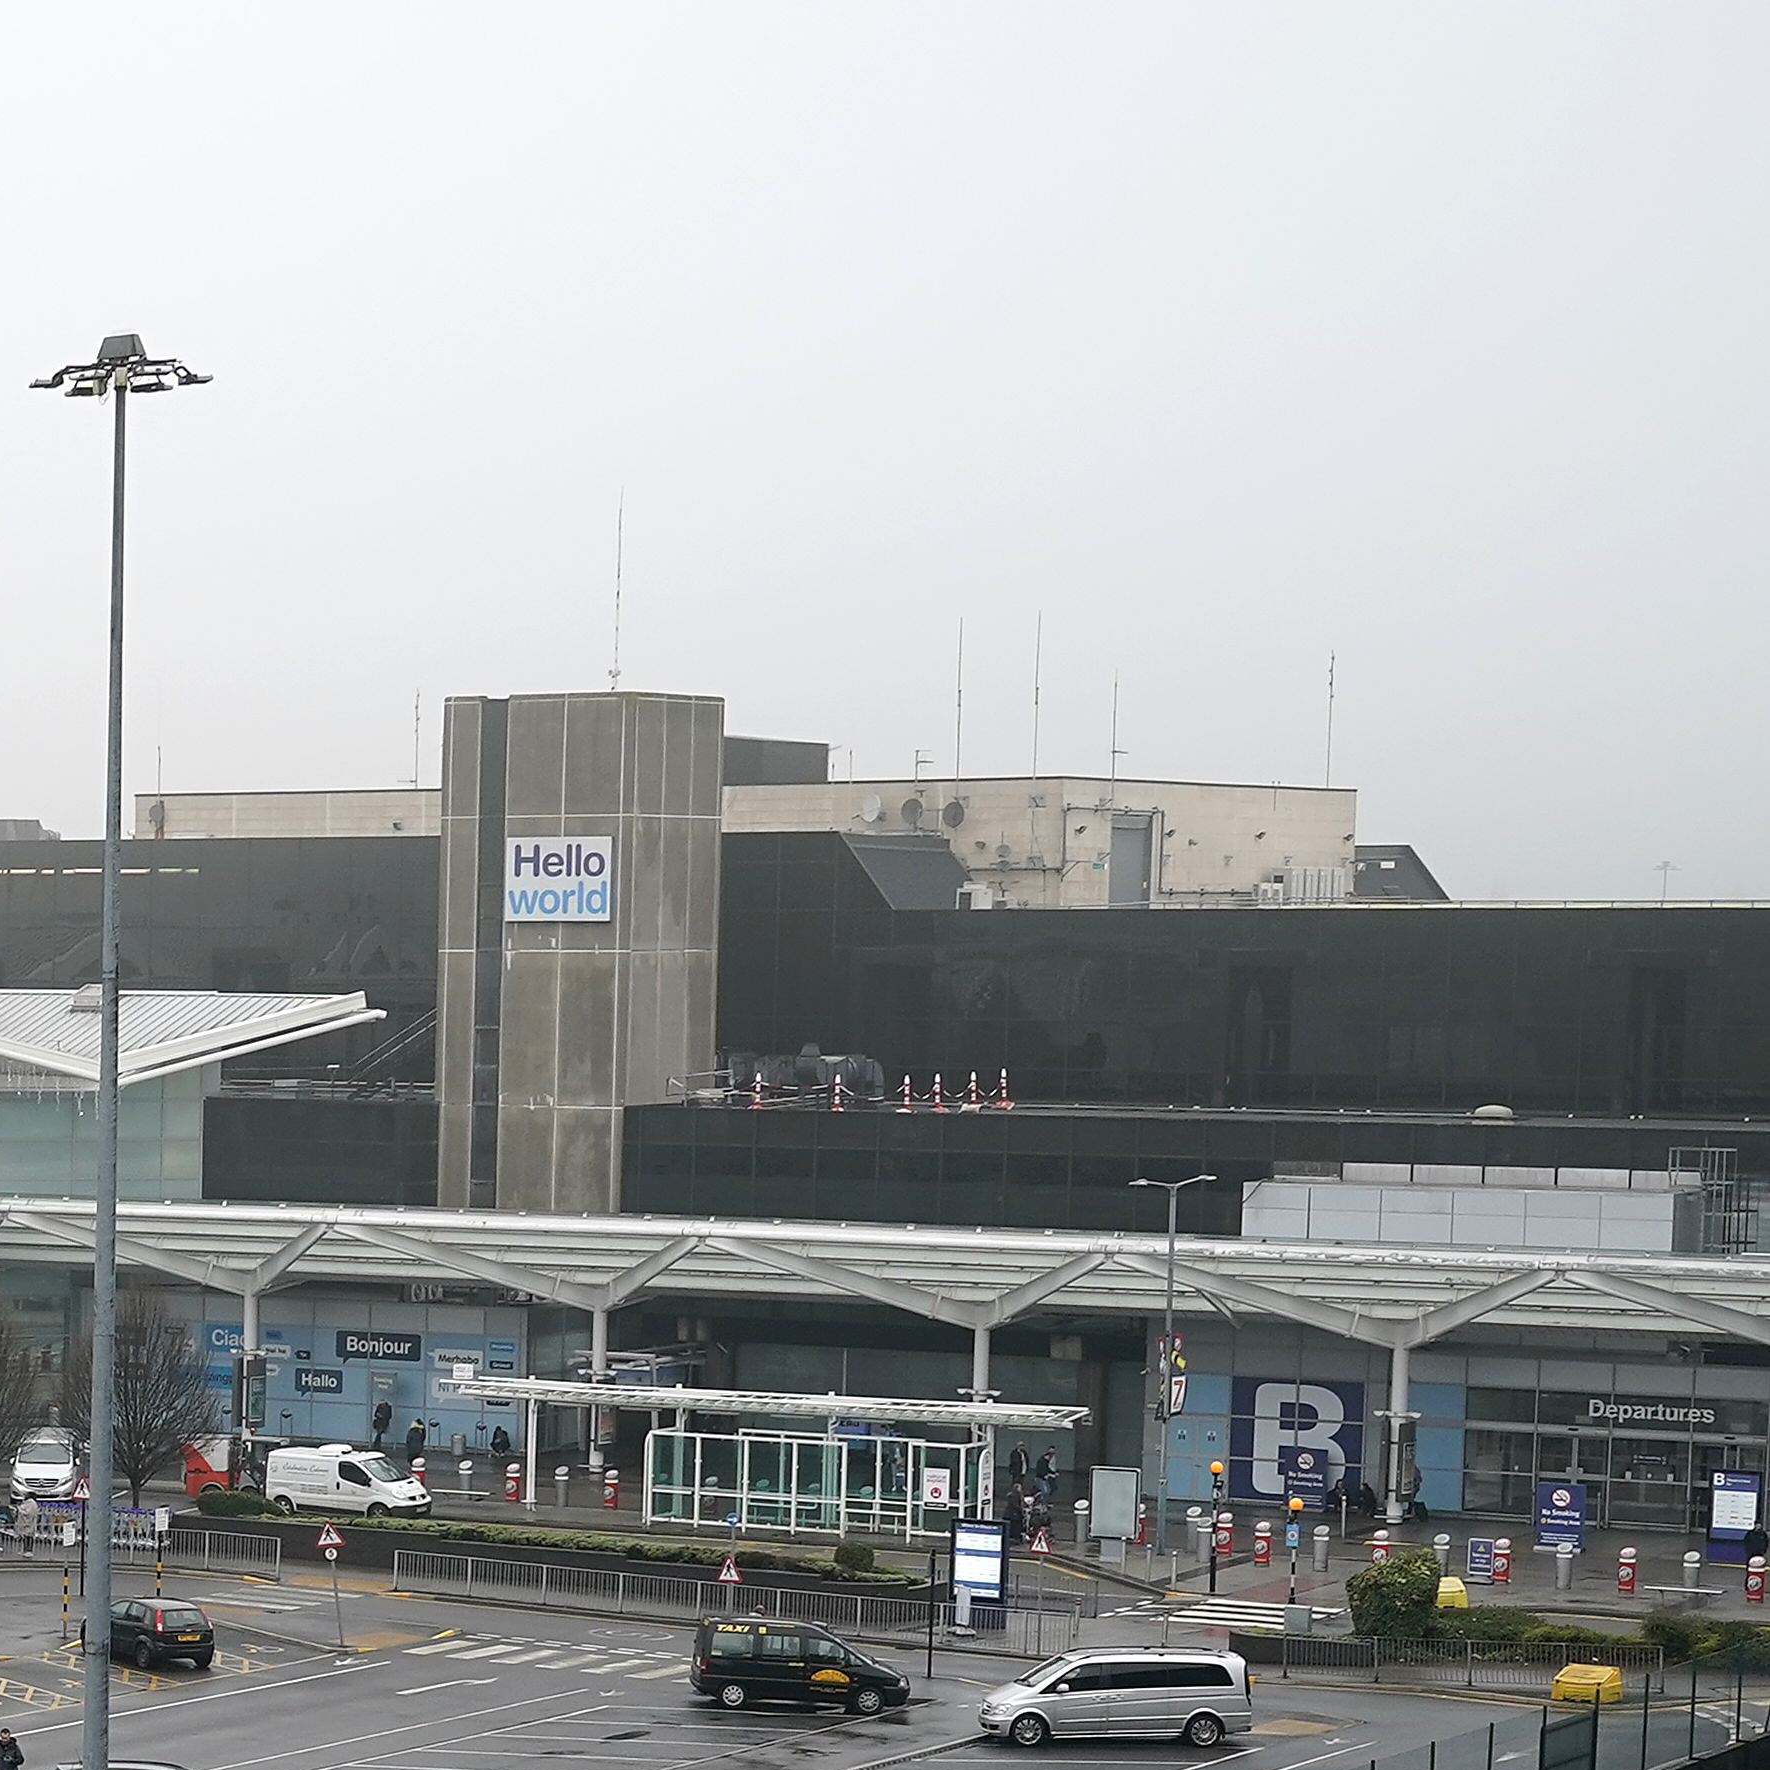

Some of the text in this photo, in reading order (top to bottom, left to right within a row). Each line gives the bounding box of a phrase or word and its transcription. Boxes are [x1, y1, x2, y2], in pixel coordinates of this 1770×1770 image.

[514, 844, 606, 877] Hello
[508, 881, 607, 914] world
[346, 1336, 411, 1357] Bonjour
[301, 1373, 337, 1388] Hallo
[1589, 1400, 1715, 1423] Departures
[1252, 1383, 1346, 1495] B
[1713, 1473, 1725, 1485] B
[1552, 1509, 1580, 1518] Smoking
[716, 1624, 750, 1633] TAXI
